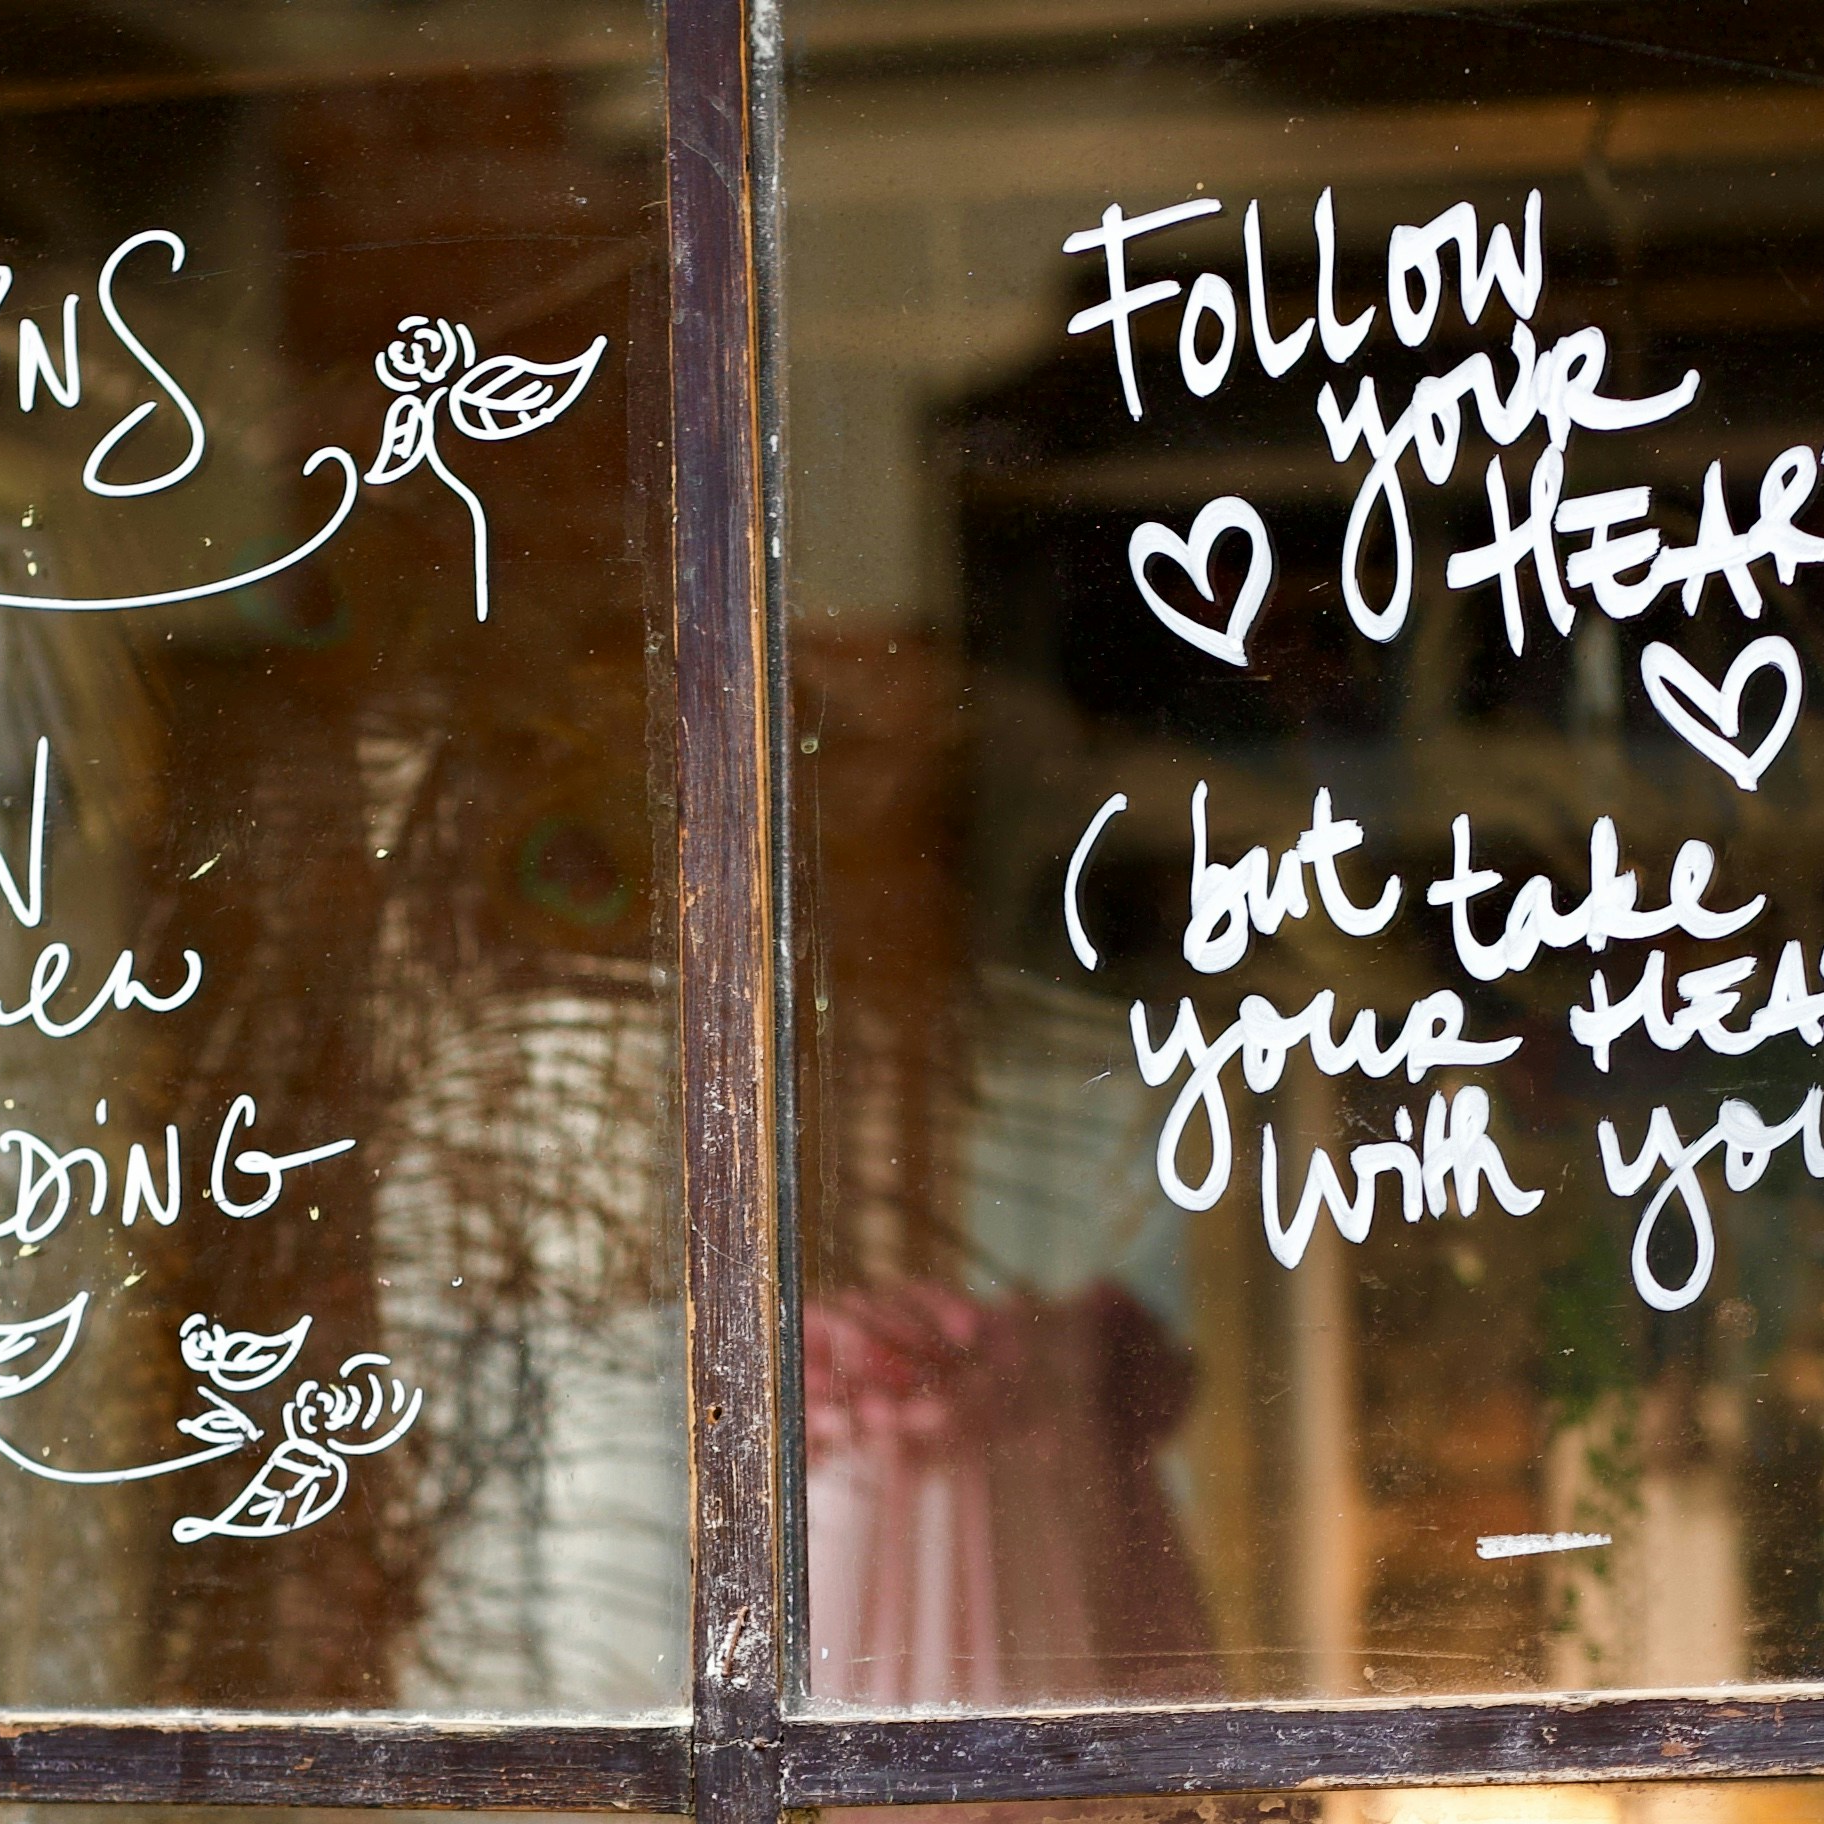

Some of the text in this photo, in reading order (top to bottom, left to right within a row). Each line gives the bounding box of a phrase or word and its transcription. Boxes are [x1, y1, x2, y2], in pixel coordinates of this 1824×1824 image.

[1062, 186, 1543, 422] Follow
[1426, 811, 1767, 983] take
[1261, 1083, 1546, 1271] with
